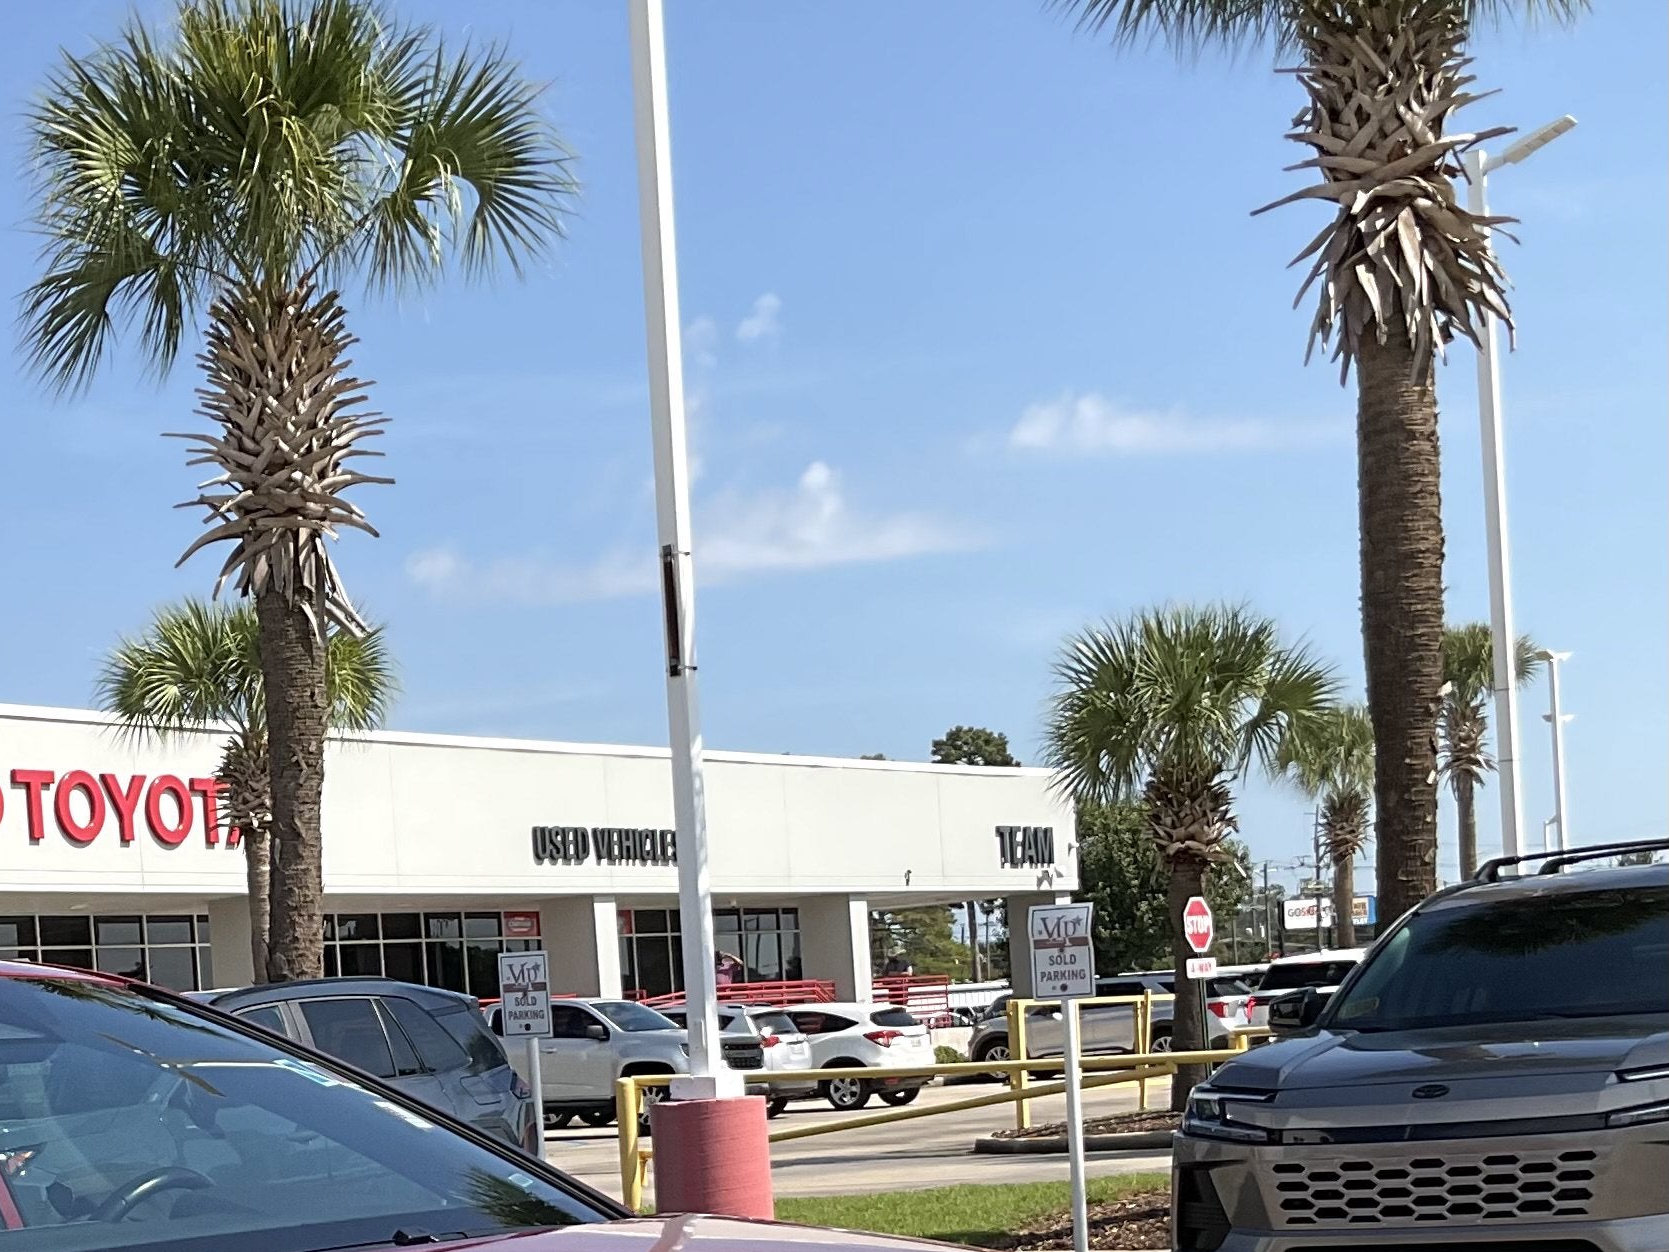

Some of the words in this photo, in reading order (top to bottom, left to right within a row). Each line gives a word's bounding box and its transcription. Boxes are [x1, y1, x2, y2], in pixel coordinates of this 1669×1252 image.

[11, 769, 241, 846] TOYOT
[532, 826, 590, 864] USED
[591, 828, 677, 865] VEHICLE
[995, 826, 1054, 865] TEAM
[1187, 915, 1210, 934] STOP
[1048, 953, 1077, 966] SOLD
[1040, 968, 1086, 982] PARKING
[514, 995, 537, 1007] SOLD
[508, 1009, 545, 1021] PARKING
